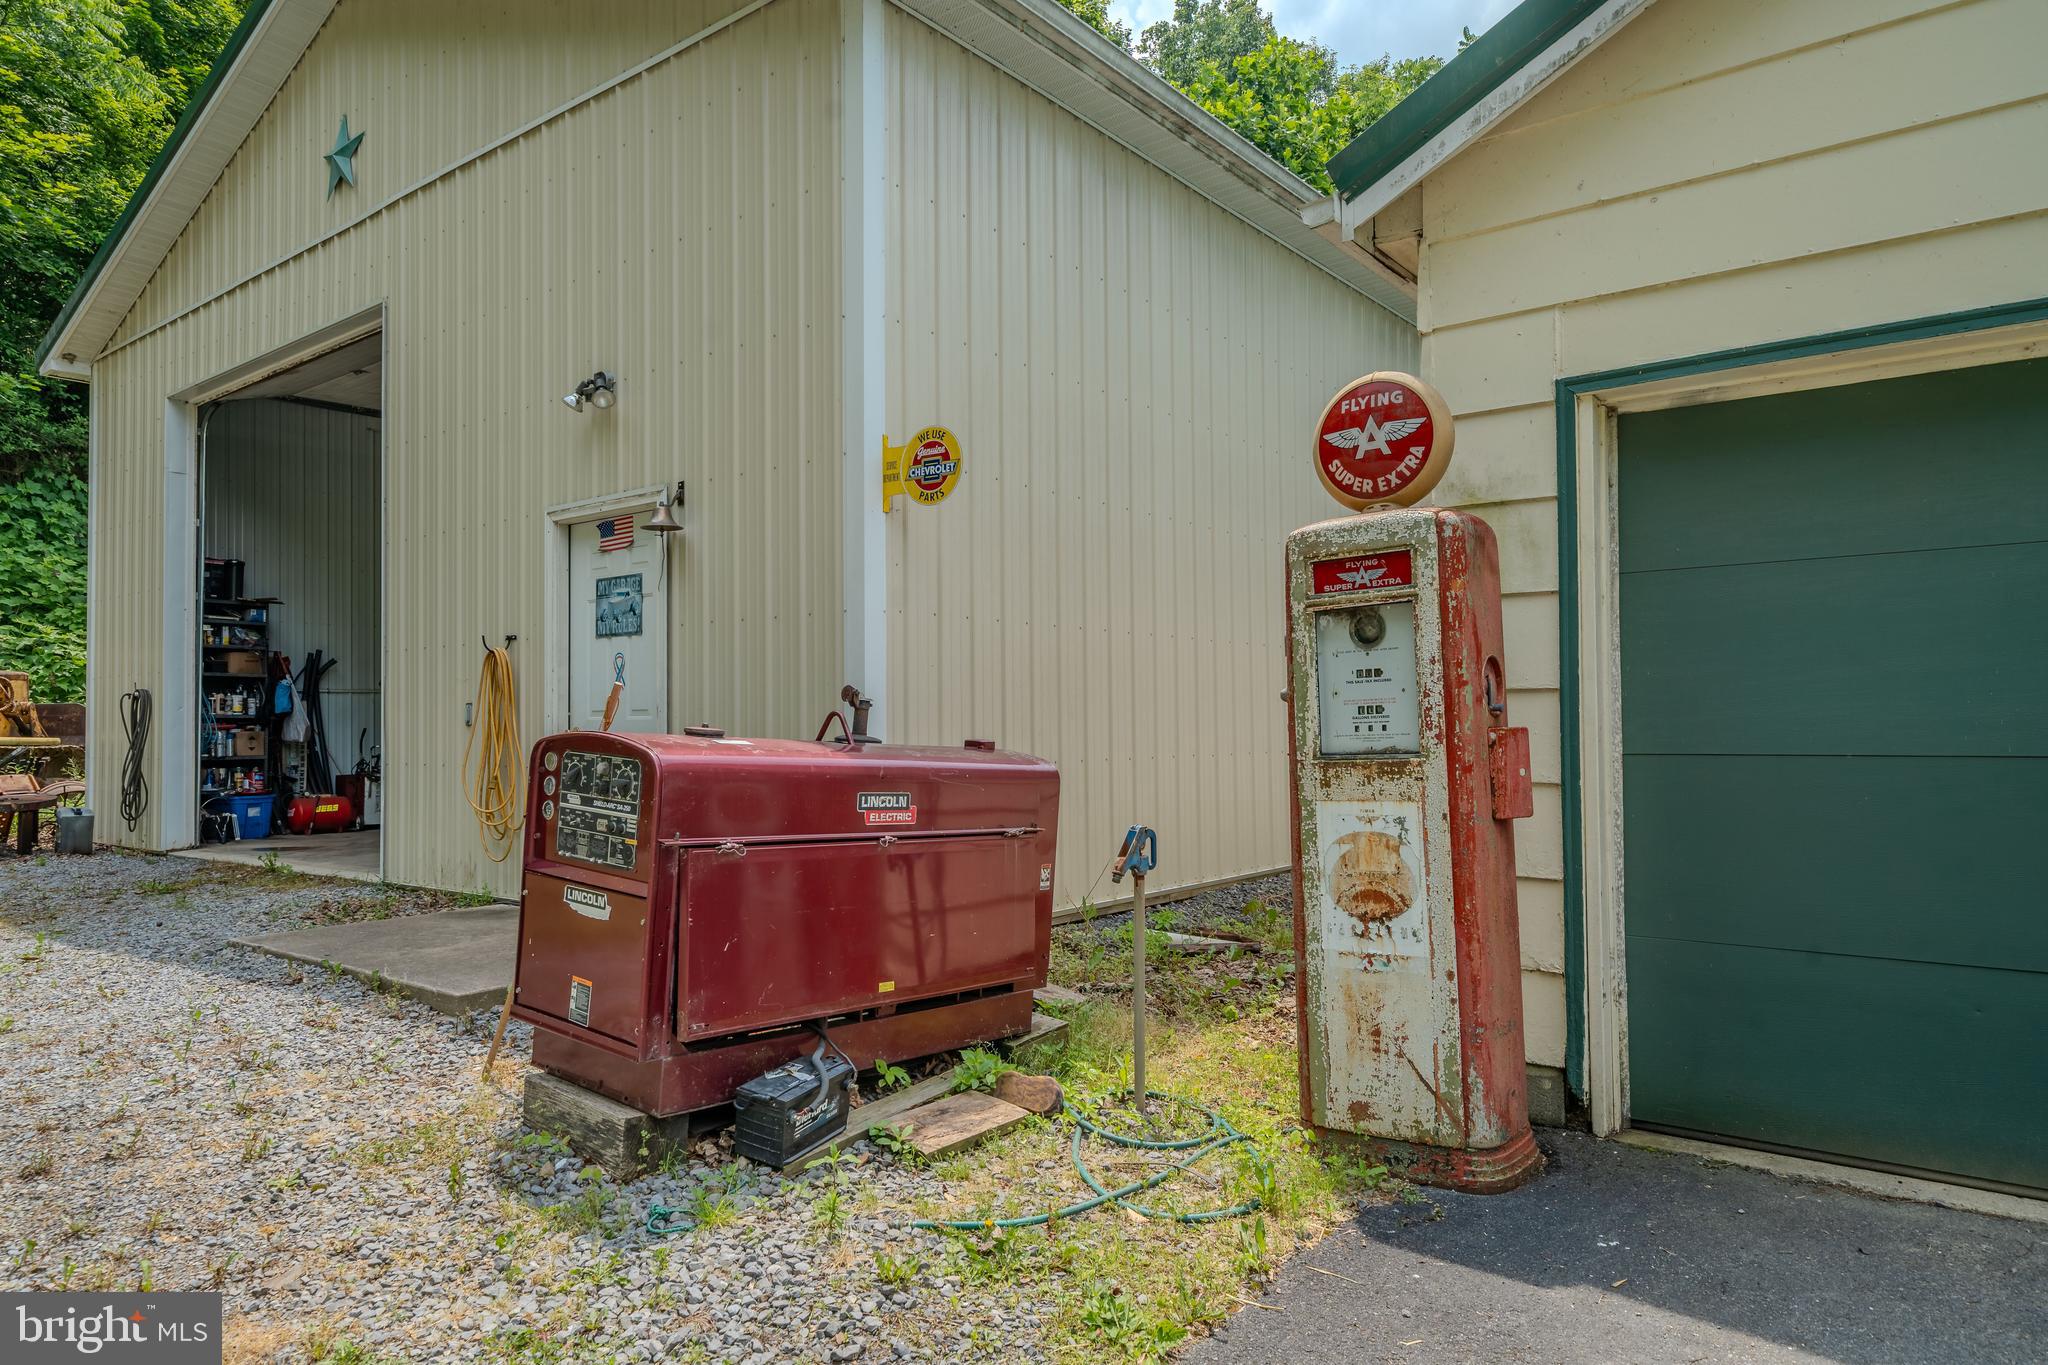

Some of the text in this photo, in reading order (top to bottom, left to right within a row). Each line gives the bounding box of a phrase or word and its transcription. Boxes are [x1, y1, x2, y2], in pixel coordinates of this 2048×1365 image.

[1341, 390, 1404, 414] FLYING
[917, 429, 946, 443] WE USE
[917, 445, 946, 460] Genuine
[909, 462, 956, 477] CHEVROLET
[1328, 446, 1426, 493] SUPER EXTRA
[918, 488, 945, 502] PARTS
[1345, 558, 1379, 569] FLYING
[597, 581, 610, 596] MY
[1323, 583, 1353, 592] SUPER
[1372, 577, 1402, 588] EXTRA
[315, 804, 339, 813] JEGS
[861, 796, 908, 808] LINCOLN
[869, 812, 912, 822] ELECTRIC
[567, 888, 606, 908] LINCOLN
